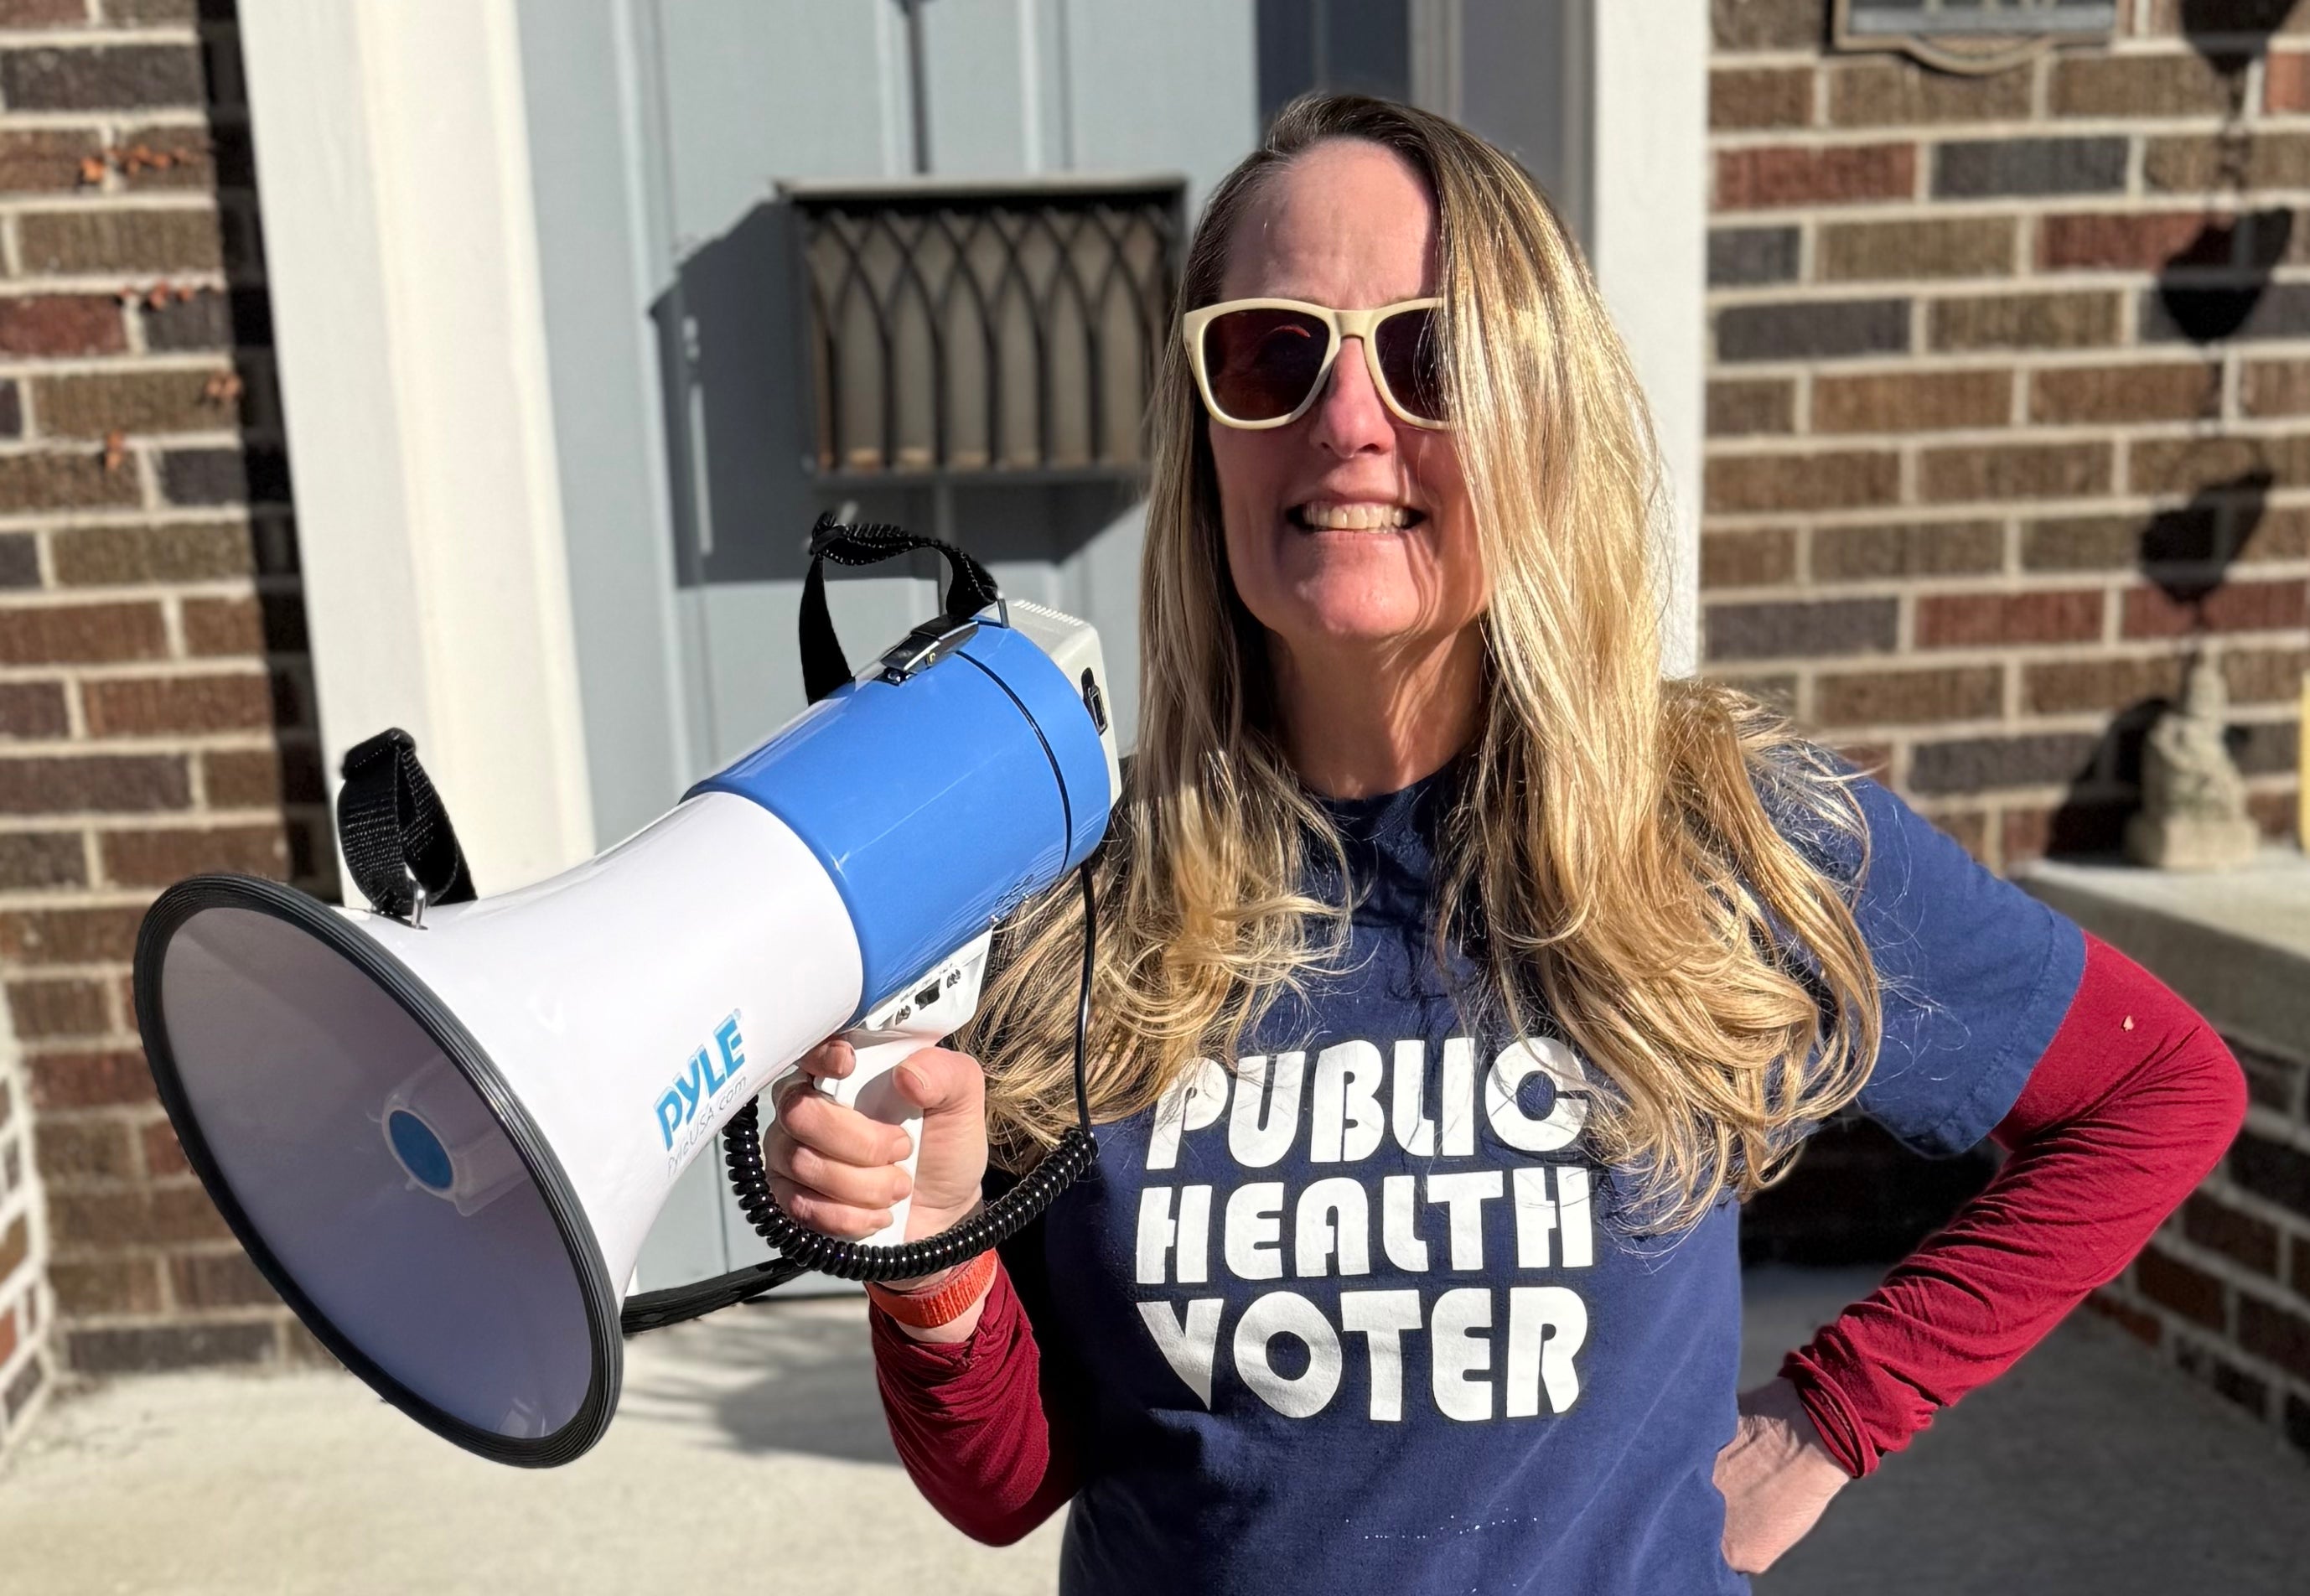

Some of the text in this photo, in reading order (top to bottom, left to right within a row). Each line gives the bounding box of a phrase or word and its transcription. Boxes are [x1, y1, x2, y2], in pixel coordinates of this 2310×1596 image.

[654, 1013, 745, 1152] PYLE
[667, 1076, 747, 1178] PyleUSAcom
[1147, 1037, 1588, 1170] PUBLIC
[1136, 1166, 1593, 1284] HEALTH
[1137, 1286, 1588, 1422] VOTER
